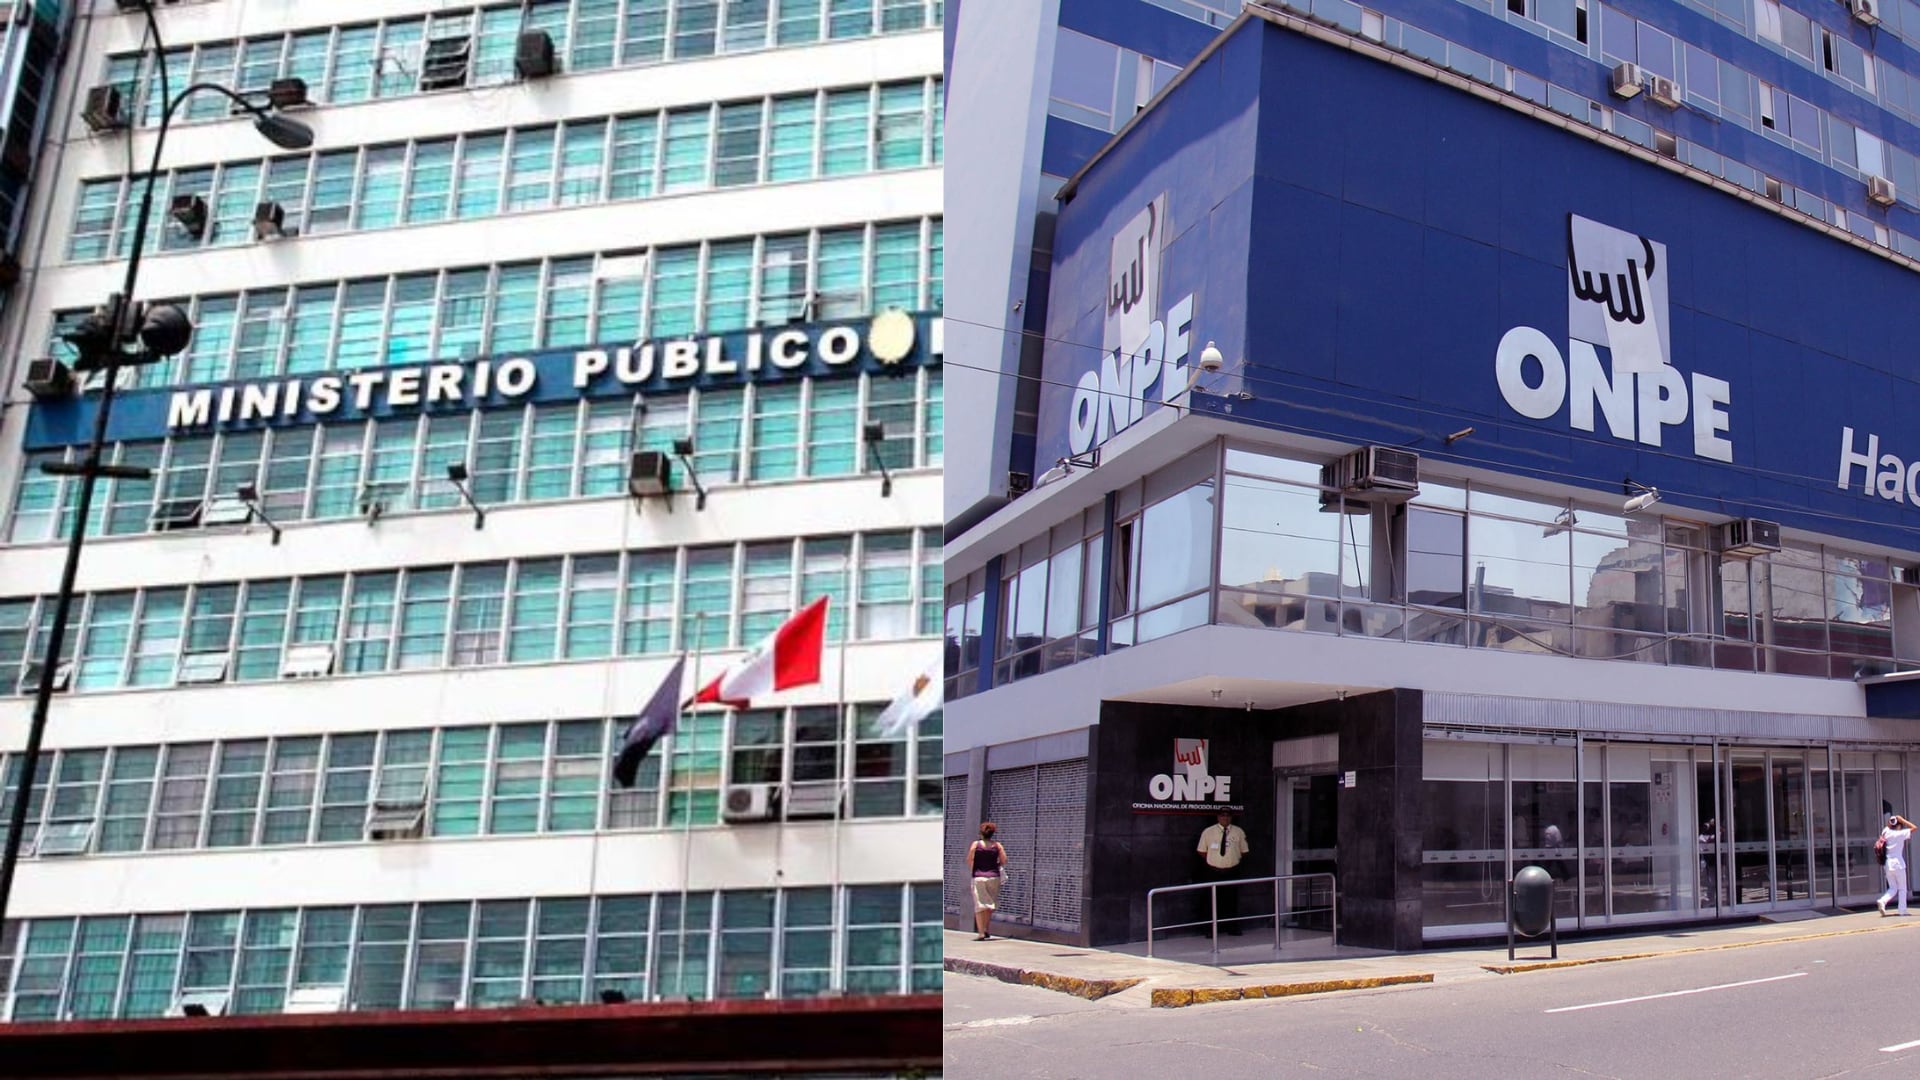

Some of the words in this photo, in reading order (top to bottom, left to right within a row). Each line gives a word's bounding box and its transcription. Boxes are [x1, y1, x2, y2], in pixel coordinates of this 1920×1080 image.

[167, 358, 536, 428] MINISTERIO
[573, 326, 860, 388] PÚBLICO
[1069, 293, 1194, 456] ONPE
[1495, 326, 1733, 463] ONPE
[1149, 773, 1231, 802] ONPE
